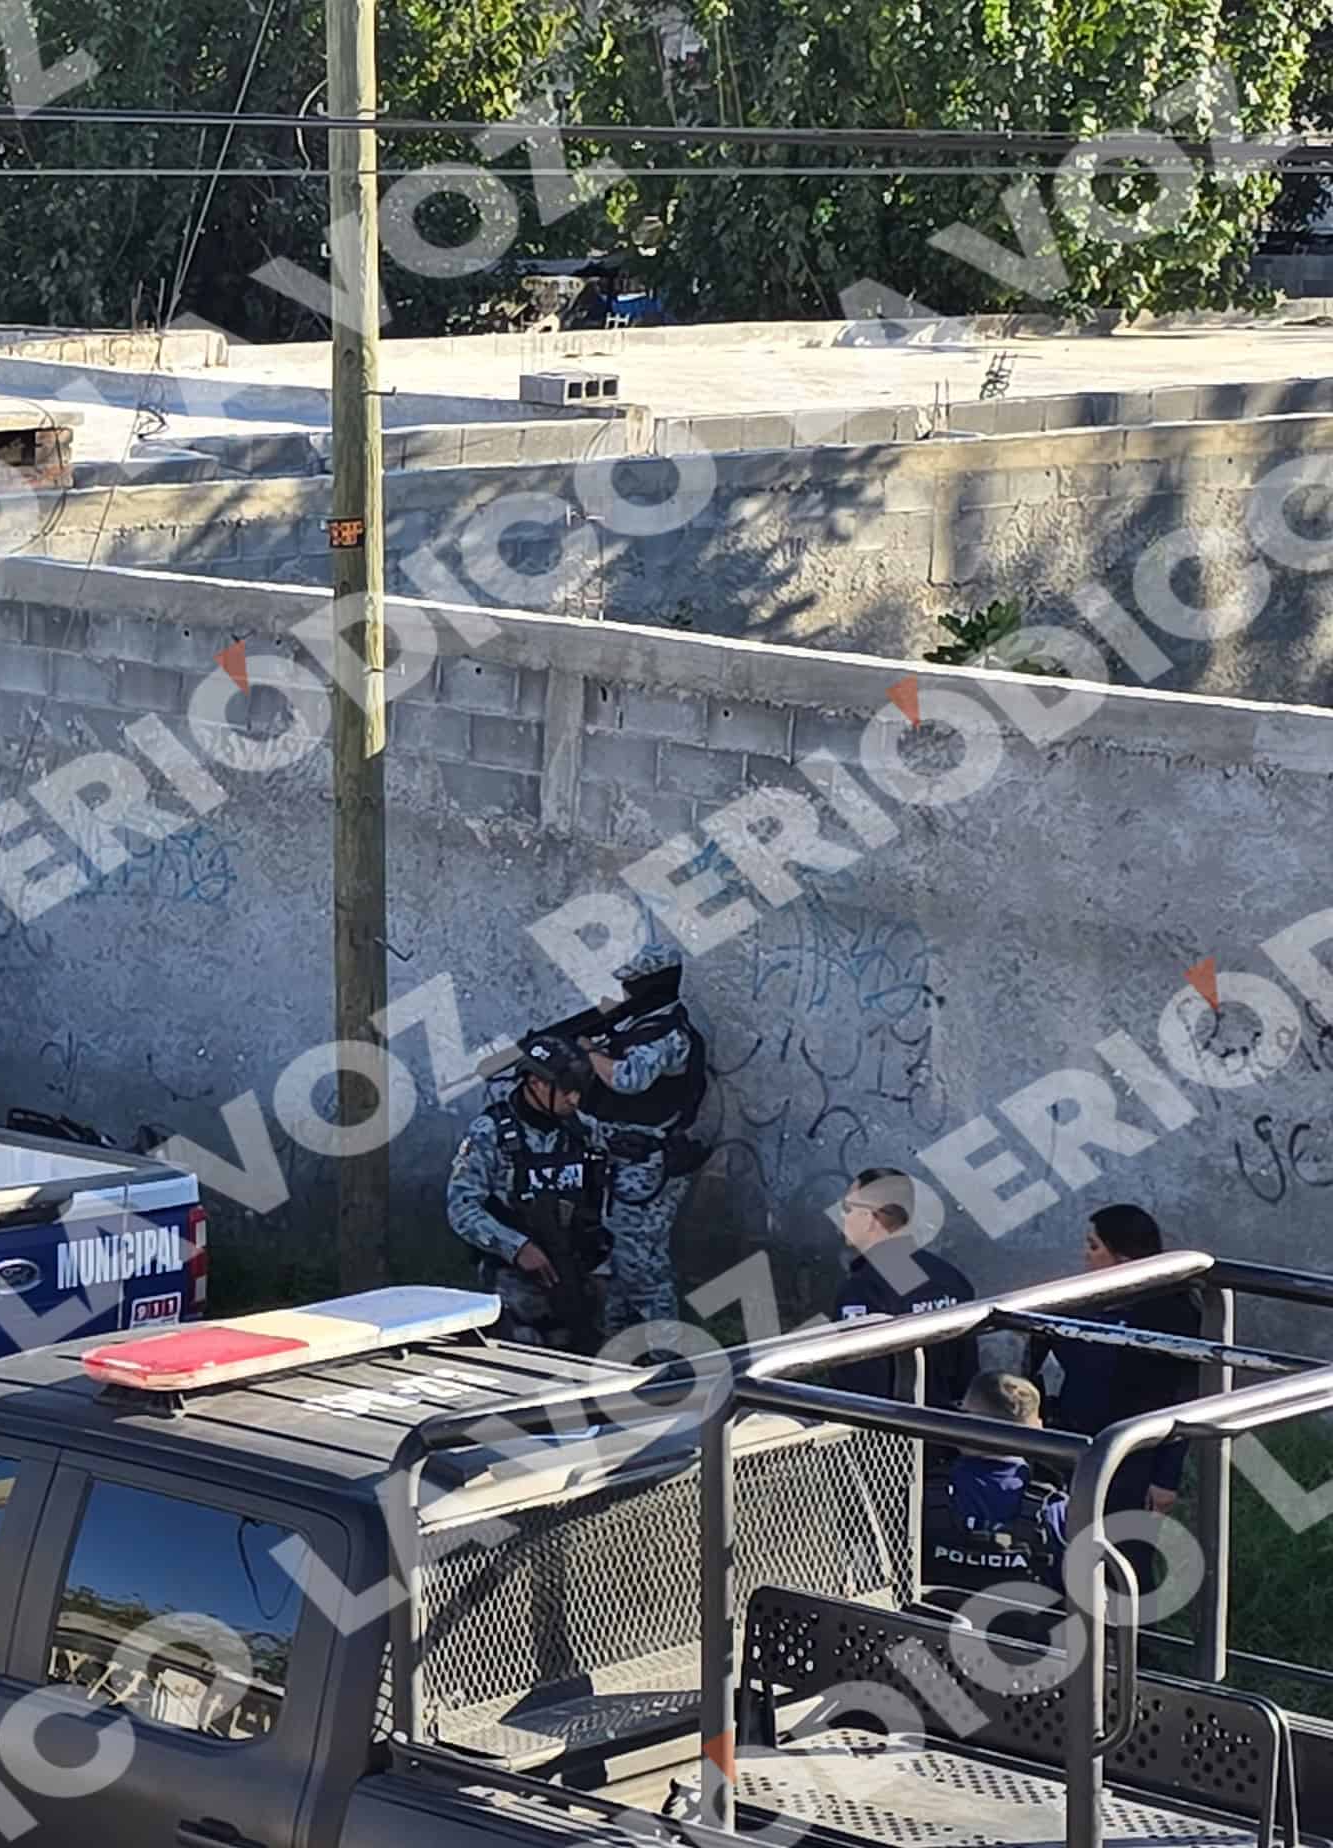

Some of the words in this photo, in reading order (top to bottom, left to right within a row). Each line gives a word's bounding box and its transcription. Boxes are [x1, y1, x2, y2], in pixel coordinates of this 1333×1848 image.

[57, 1225, 184, 1290] MUNICIPAL
[137, 1299, 175, 1320] 911
[933, 1545, 1028, 1569] POLICIA
